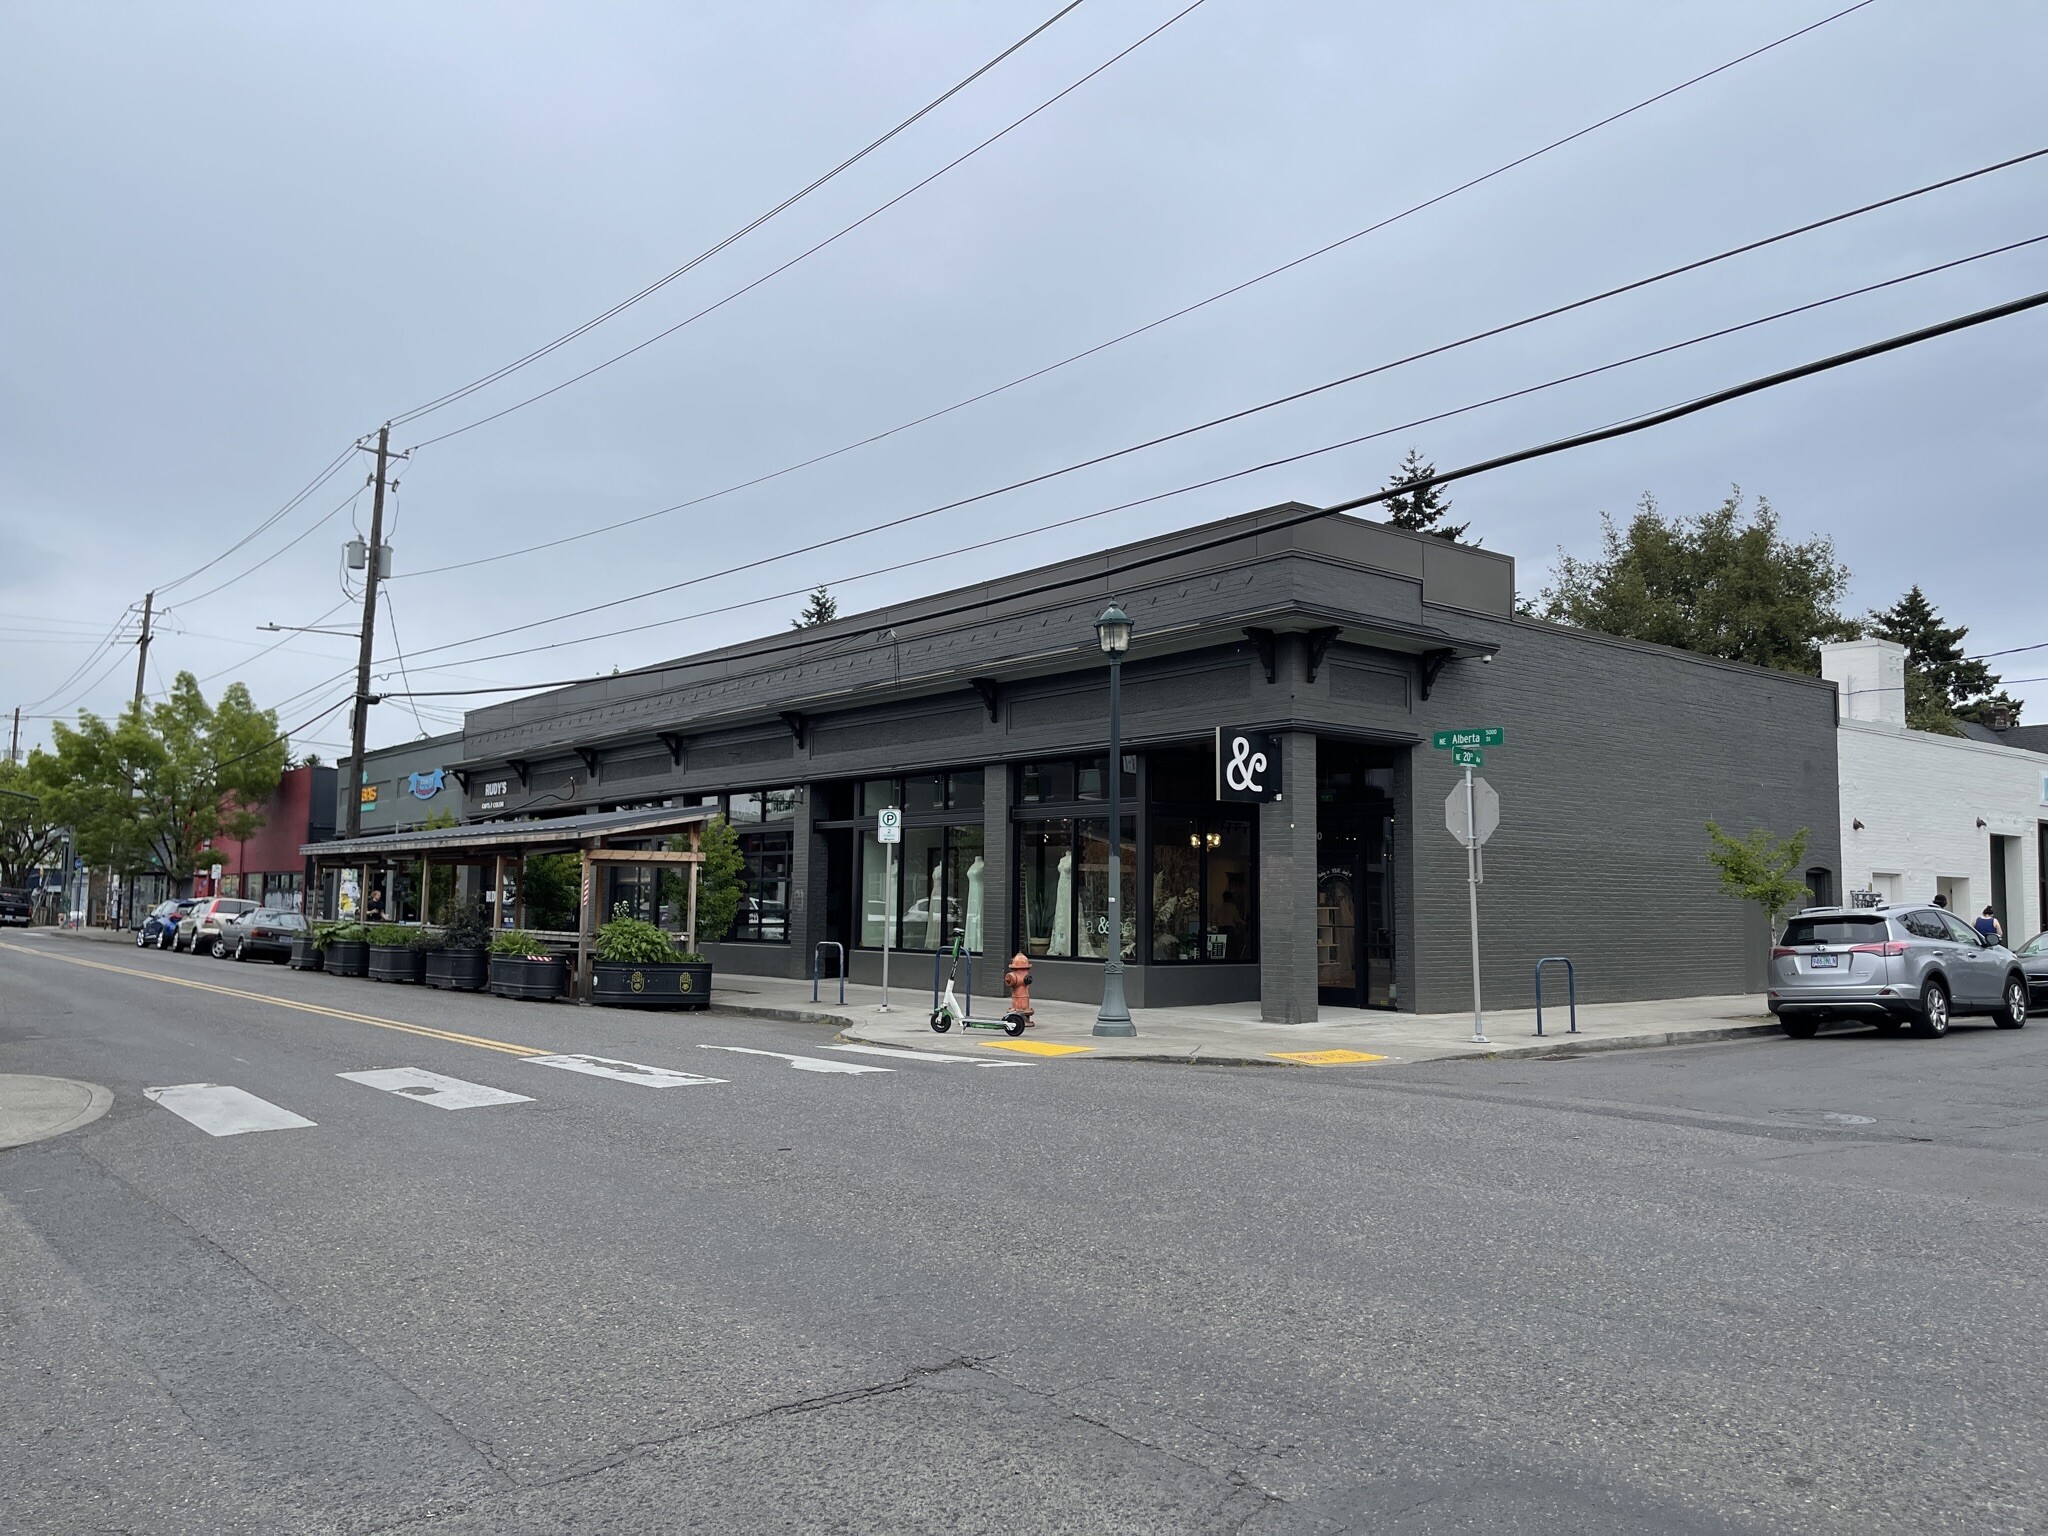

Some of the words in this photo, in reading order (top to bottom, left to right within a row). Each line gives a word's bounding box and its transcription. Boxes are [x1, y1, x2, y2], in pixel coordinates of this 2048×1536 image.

[1452, 733, 1480, 744] Alberta
[1226, 736, 1268, 792] &
[485, 781, 507, 796] RUDY'S
[887, 815, 894, 823] P
[1098, 916, 1109, 934] &
